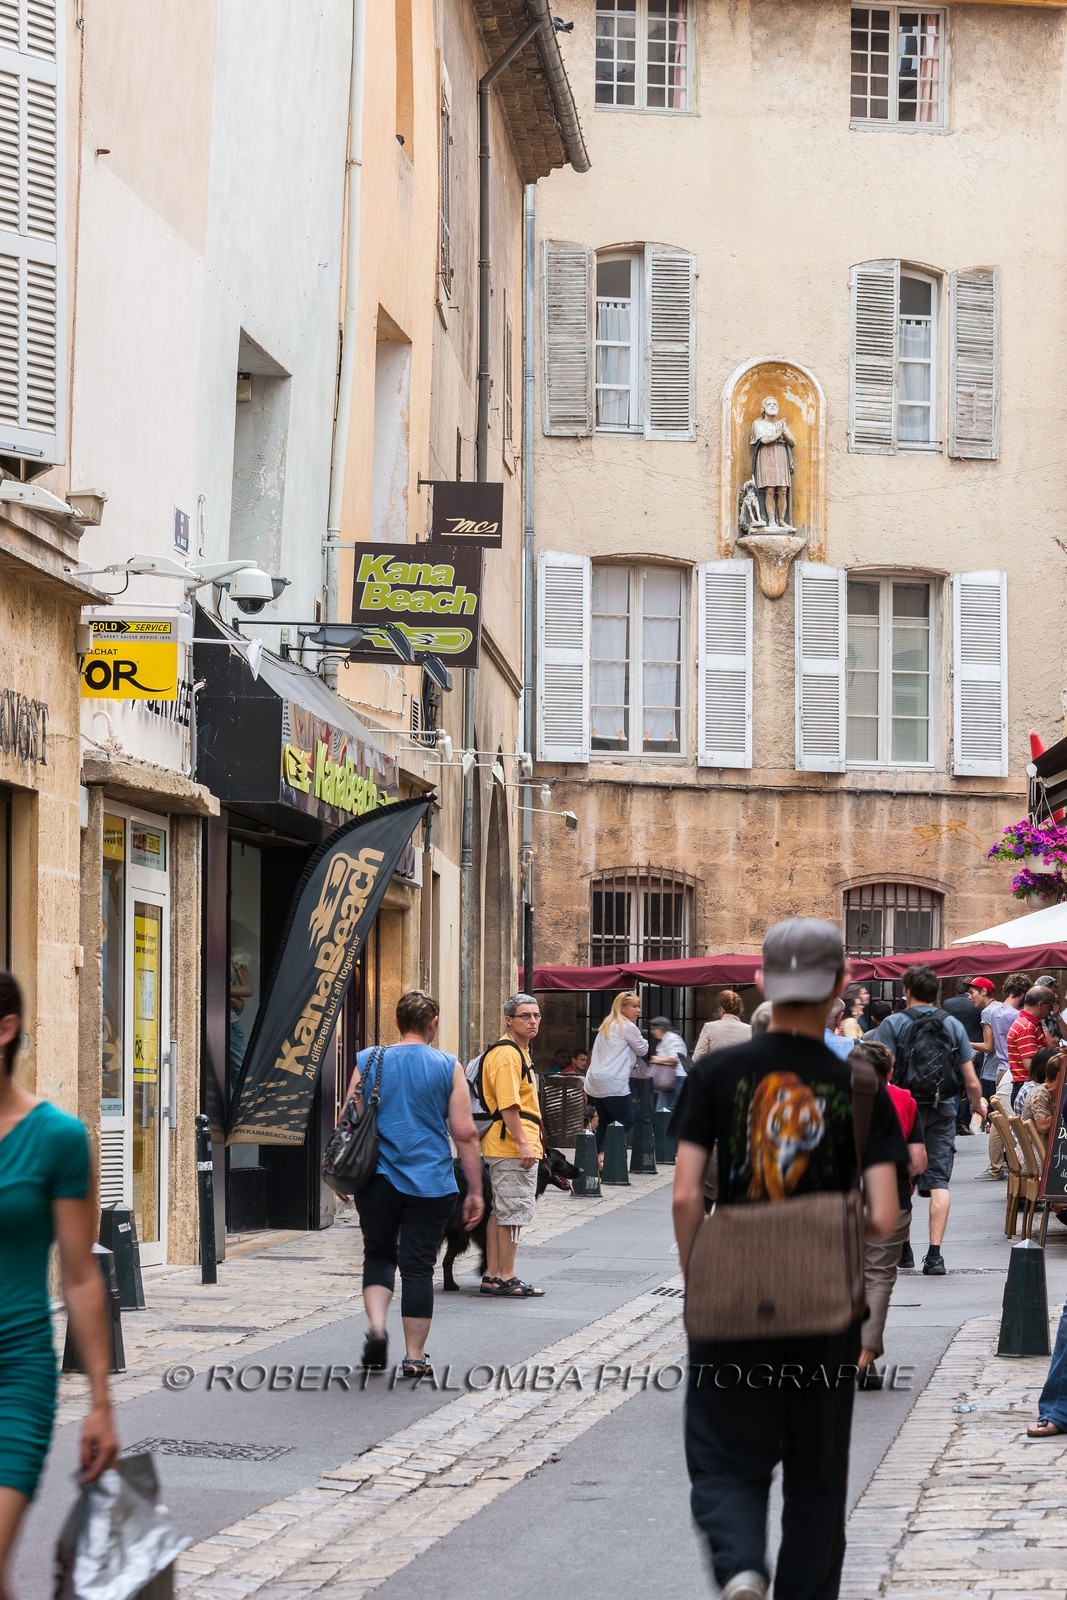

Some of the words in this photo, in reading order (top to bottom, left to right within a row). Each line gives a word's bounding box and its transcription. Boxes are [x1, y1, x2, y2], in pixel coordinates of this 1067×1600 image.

[357, 554, 455, 586] Kana
[359, 582, 478, 615] Beach
[92, 622, 118, 631] GOLD
[135, 623, 169, 632] SERVICE
[84, 660, 173, 692] OR
[0, 688, 48, 766] OVOST
[313, 740, 378, 816] KanaBeach
[274, 847, 385, 1076] KanaBeach
[304, 1066, 317, 1080] All
[311, 1016, 332, 1063] different
[325, 996, 339, 1015] but
[332, 981, 344, 995] all
[338, 934, 361, 982] together
[230, 1128, 304, 1141] WW.KANABEACH.COM
